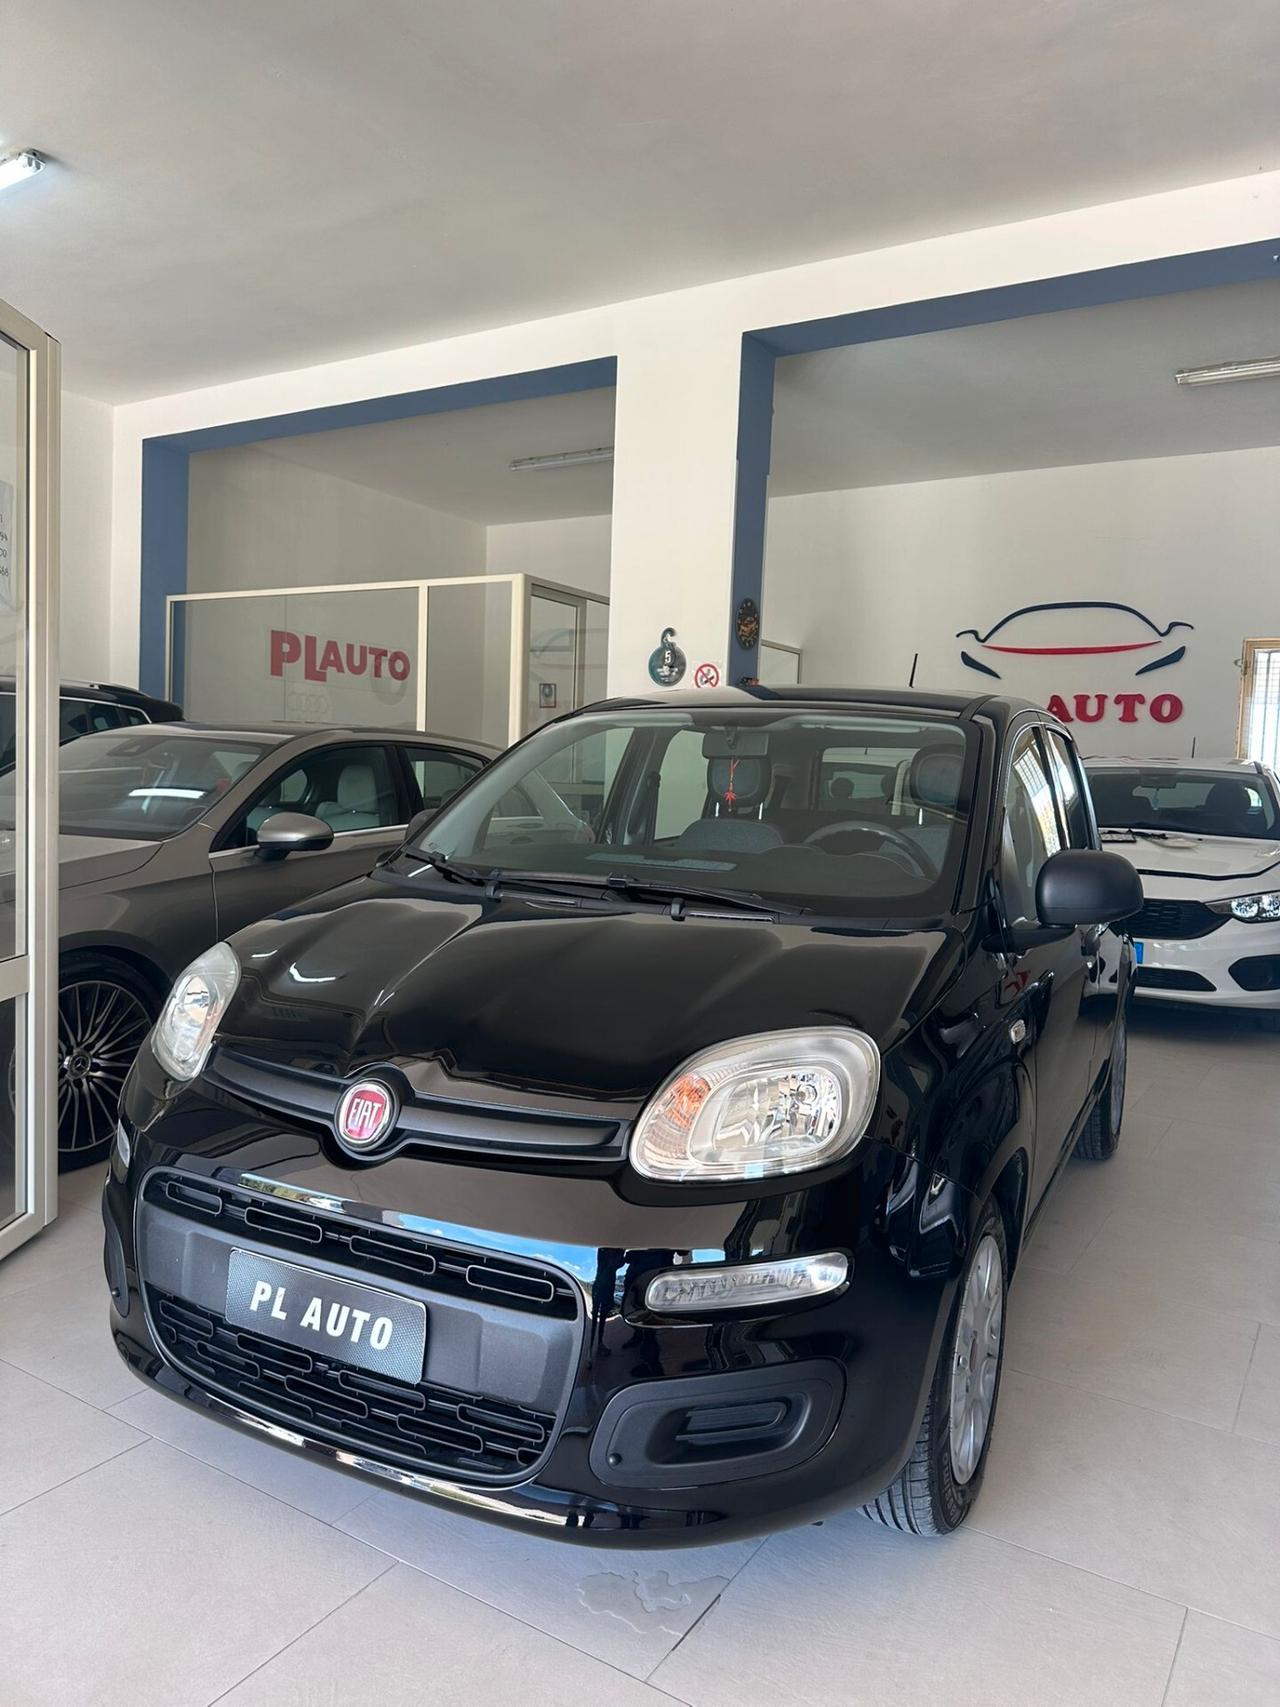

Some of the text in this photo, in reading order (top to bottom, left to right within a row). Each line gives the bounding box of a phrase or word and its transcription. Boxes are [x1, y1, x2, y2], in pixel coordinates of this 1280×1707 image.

[1046, 693, 1183, 724] AUTO
[347, 1097, 382, 1130] FIAT
[249, 1280, 394, 1351] PL AUTO
